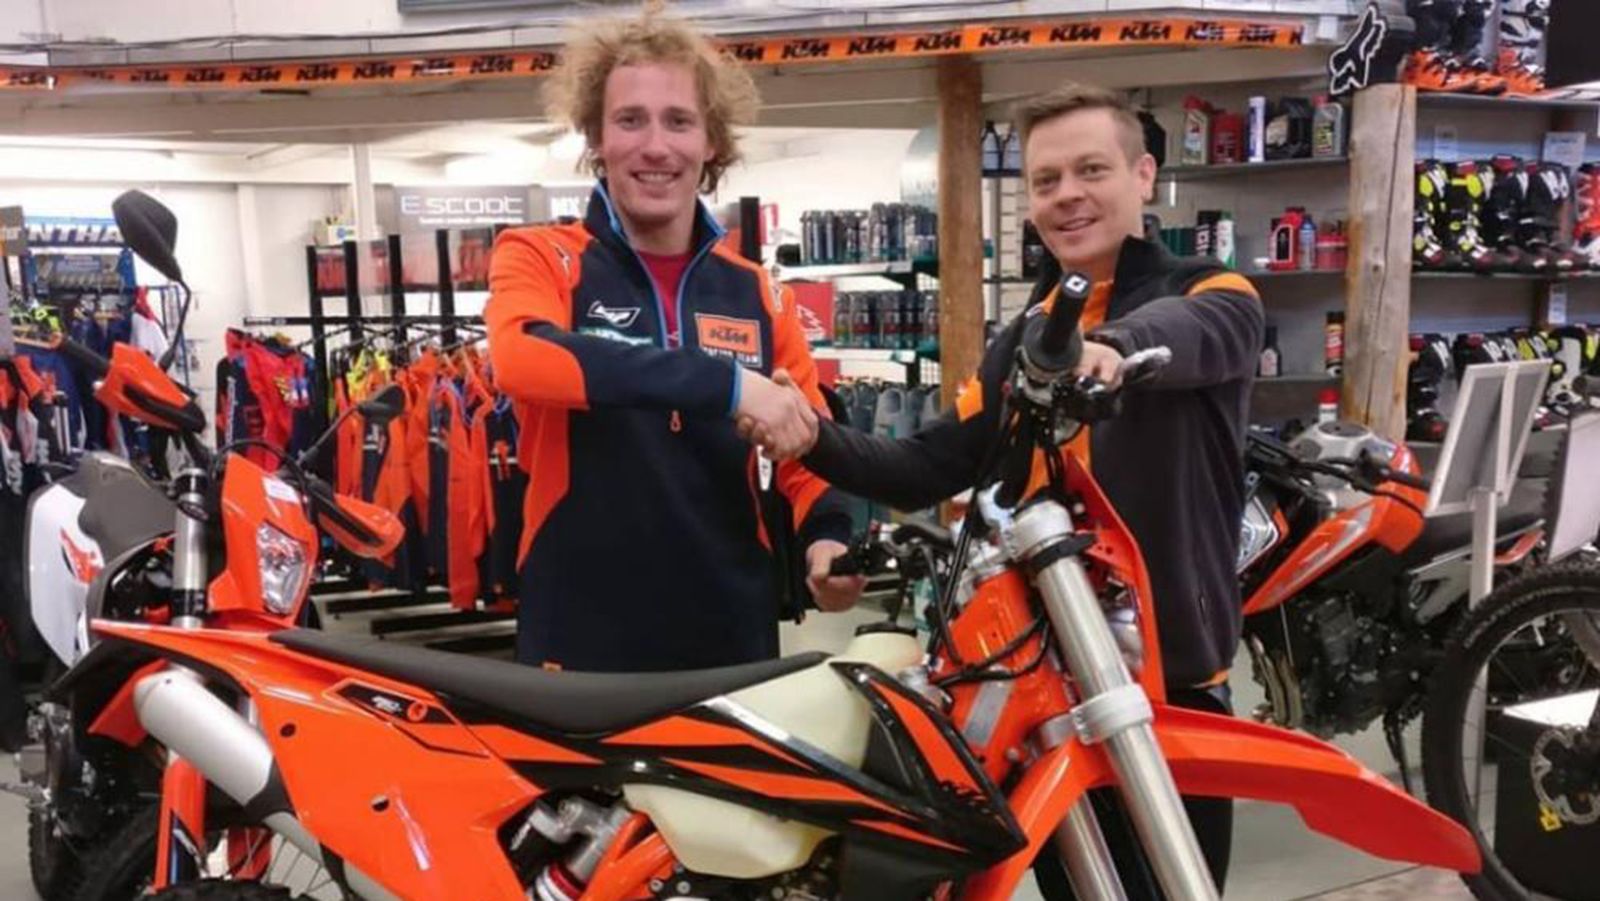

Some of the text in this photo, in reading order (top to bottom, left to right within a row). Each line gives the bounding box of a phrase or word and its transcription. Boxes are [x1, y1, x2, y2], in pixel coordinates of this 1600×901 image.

[185, 66, 225, 82] KTM
[239, 64, 283, 82] KTM
[296, 63, 338, 81] KTM
[353, 60, 396, 78] KTM
[470, 54, 514, 73] KTM
[780, 38, 829, 59] KTM
[846, 35, 897, 55] KTM
[912, 30, 961, 51] KTM
[978, 26, 1031, 46] KTM
[1049, 22, 1102, 43] KTM
[1119, 20, 1171, 40] KTM
[1184, 20, 1224, 41] KTM
[28, 222, 125, 242] NTHA
[709, 325, 749, 345] KTM
